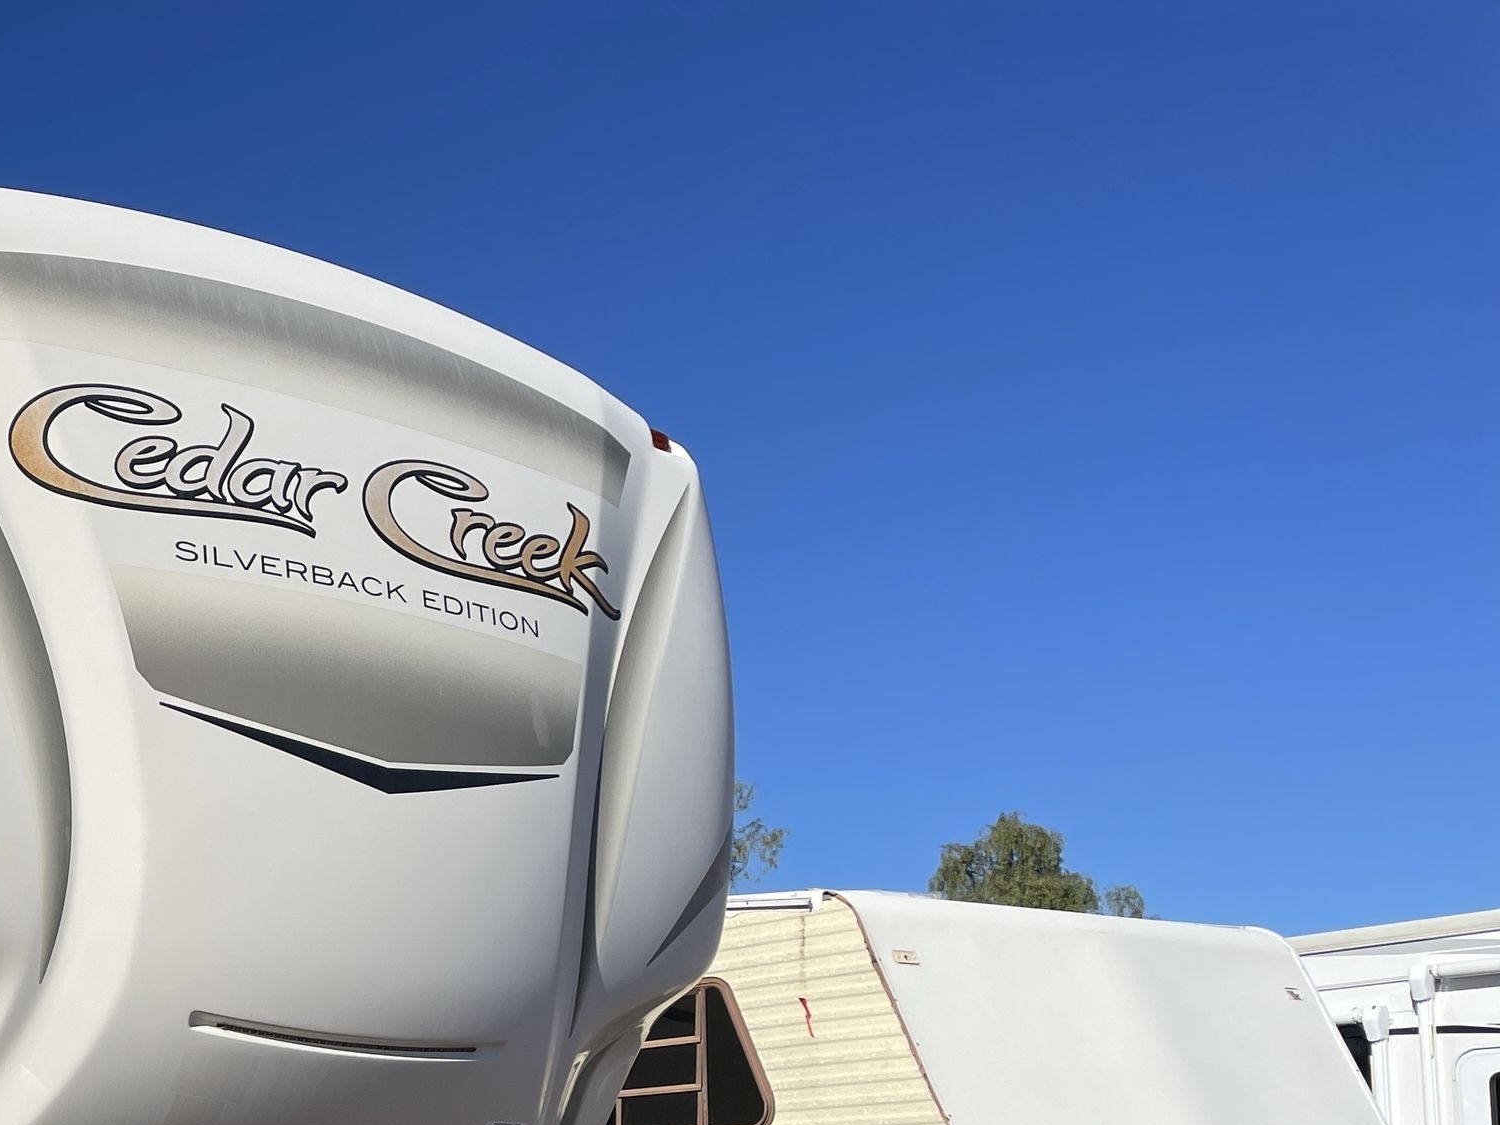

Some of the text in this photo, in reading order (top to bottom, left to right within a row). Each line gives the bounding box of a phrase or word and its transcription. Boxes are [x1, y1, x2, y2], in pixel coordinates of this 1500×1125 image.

[8, 383, 621, 620] Cedar Creek
[174, 539, 540, 638] SILVERBACK EDITION
